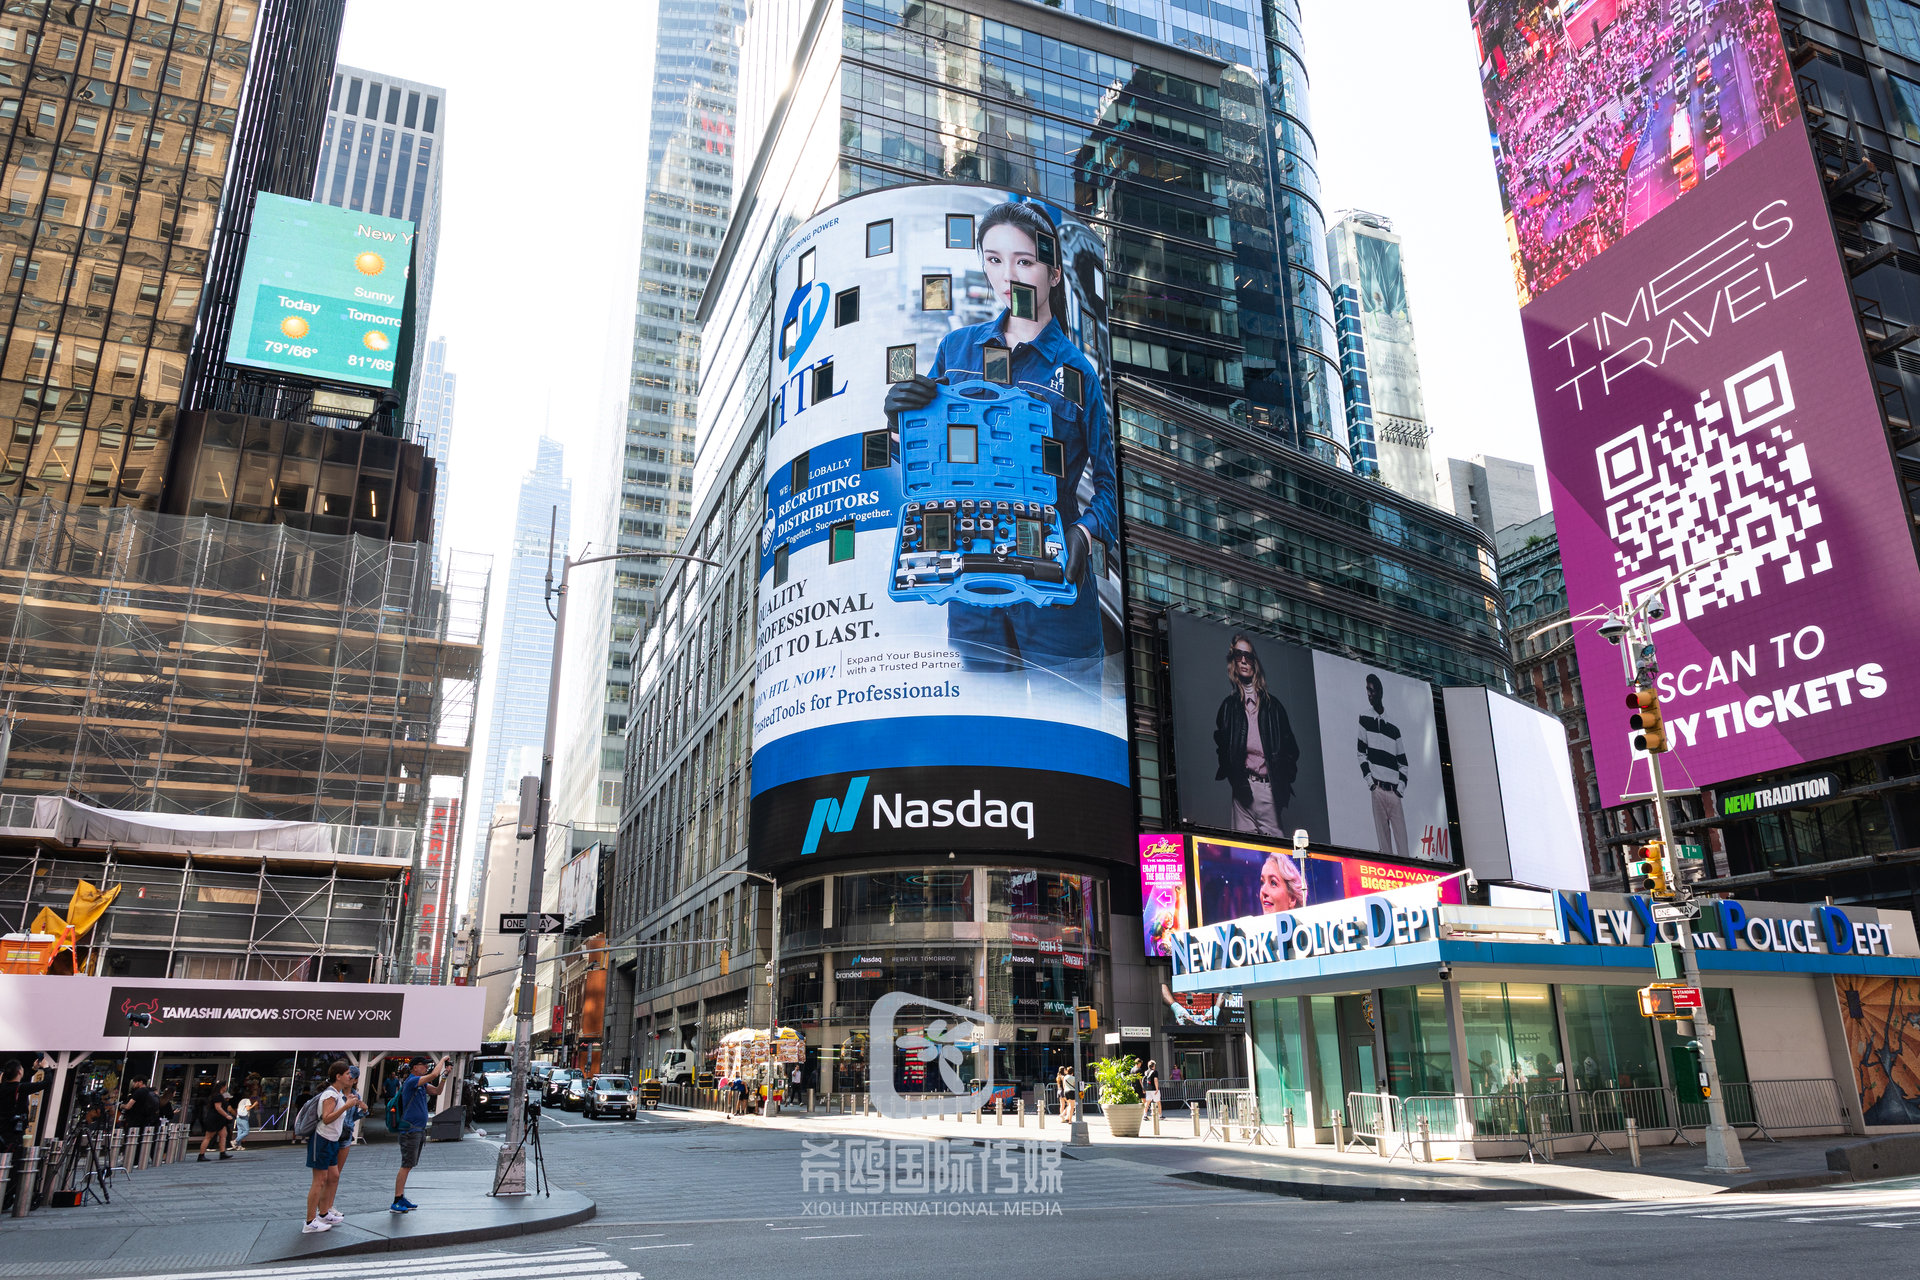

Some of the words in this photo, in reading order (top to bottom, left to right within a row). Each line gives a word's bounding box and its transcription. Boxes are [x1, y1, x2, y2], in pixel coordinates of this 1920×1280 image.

[357, 224, 397, 242] New
[812, 217, 839, 237] POWER
[1548, 199, 1794, 368] TIMES
[278, 295, 321, 315] Today
[354, 287, 395, 304] Sunny
[1556, 261, 1808, 411] TRAVEL
[264, 340, 318, 358] 79°/66°
[348, 355, 394, 371] 81°/69
[1050, 379, 1064, 392] HT
[809, 458, 851, 480] LOBALLY
[778, 474, 861, 518] RECRUITING
[779, 485, 789, 496] WE
[777, 490, 880, 538] DISTRIBUTORS
[786, 528, 813, 544] Together.
[849, 509, 893, 522] Together.
[756, 593, 874, 655] PROFESSIONAL
[756, 644, 783, 680] BUILT
[787, 634, 810, 658] TO
[815, 620, 880, 648] LAST.
[847, 653, 883, 665] Expand
[886, 652, 911, 660] Your
[913, 650, 960, 659] Business
[847, 666, 867, 675] with
[879, 661, 918, 671] Trusted
[1656, 644, 1756, 704] SCAN
[1769, 625, 1825, 668] TO
[768, 678, 789, 699] HTL
[793, 665, 836, 688] NOW!
[810, 693, 832, 712] for
[836, 680, 960, 706] Professionals
[1706, 662, 1888, 739] TICKETS
[873, 789, 1034, 840] Nasdaq
[427, 807, 447, 866] PARK
[1421, 824, 1449, 859] H&M
[1158, 864, 1166, 872] NO
[1166, 864, 1176, 872] FEES
[1177, 864, 1182, 872] AT
[1165, 873, 1180, 881] OFFICE
[1360, 865, 1441, 882] BROADWAY'S
[425, 880, 438, 891] M
[1361, 876, 1403, 890] BIGGEST
[1656, 908, 1671, 917] ONE
[1678, 905, 1694, 914] WAY
[506, 919, 525, 928] ONE
[540, 919, 552, 928] AY
[1552, 889, 1633, 945] NEW
[1631, 895, 1720, 948] YO
[1718, 899, 1820, 953] POLICE
[1819, 905, 1893, 955] DEPT
[416, 904, 435, 966] PARK
[1171, 931, 1216, 976] NEW
[1215, 923, 1276, 969] YORK
[1276, 912, 1360, 962] POLICE
[1365, 896, 1440, 949] DEPT
[1012, 956, 1035, 964] Nasdaq
[162, 1007, 222, 1019] TAMASHII
[282, 1009, 323, 1022] STORE
[327, 1009, 356, 1021] NEW
[357, 1009, 391, 1021] YORK
